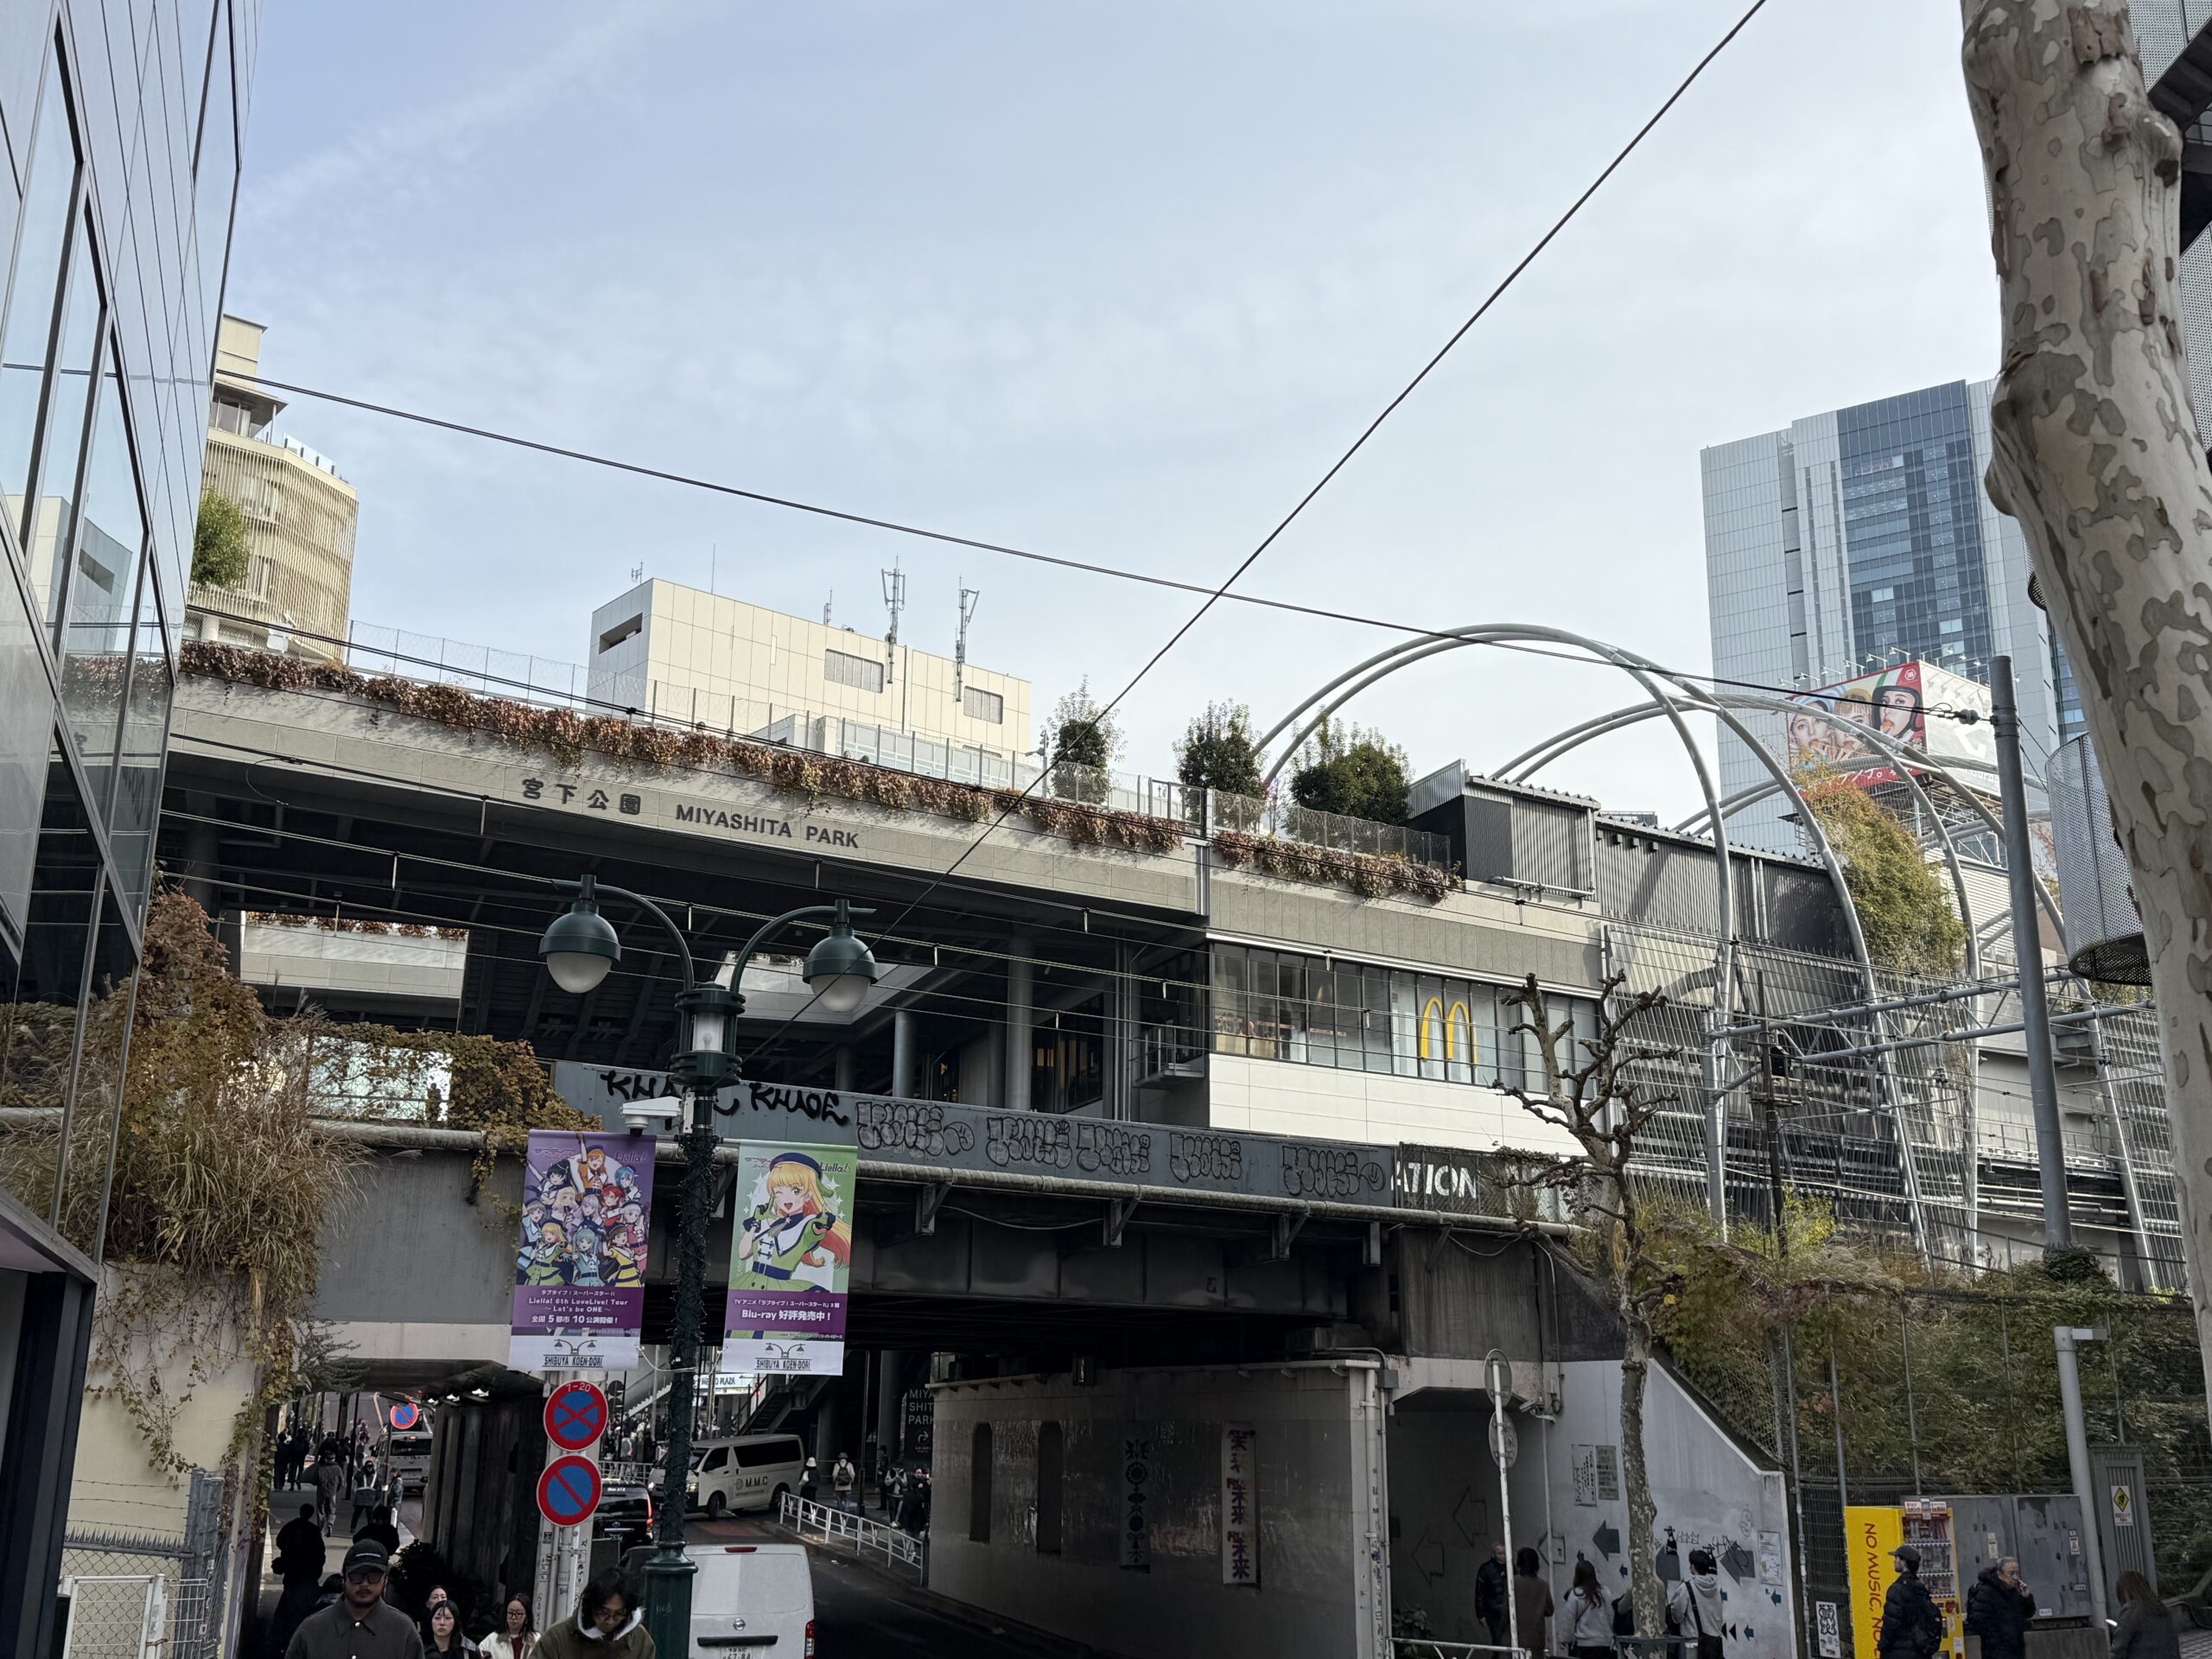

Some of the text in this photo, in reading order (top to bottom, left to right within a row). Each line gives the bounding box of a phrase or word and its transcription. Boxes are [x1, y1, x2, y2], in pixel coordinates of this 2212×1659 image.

[522, 777, 641, 816] 宮下公園
[676, 804, 860, 849] MIYASHITA PARK
[820, 1161, 849, 1174] Liella!
[741, 1310, 777, 1320] Blu-ray
[544, 1355, 603, 1367] SHIBUYA KOEN-DORI
[756, 1359, 810, 1370] SHIBUYA KOEN-DORI
[720, 1376, 735, 1386] PLAZA
[565, 1382, 591, 1393] 7-20
[909, 1402, 933, 1412] SHIT
[1865, 1523, 1878, 1549] NO
